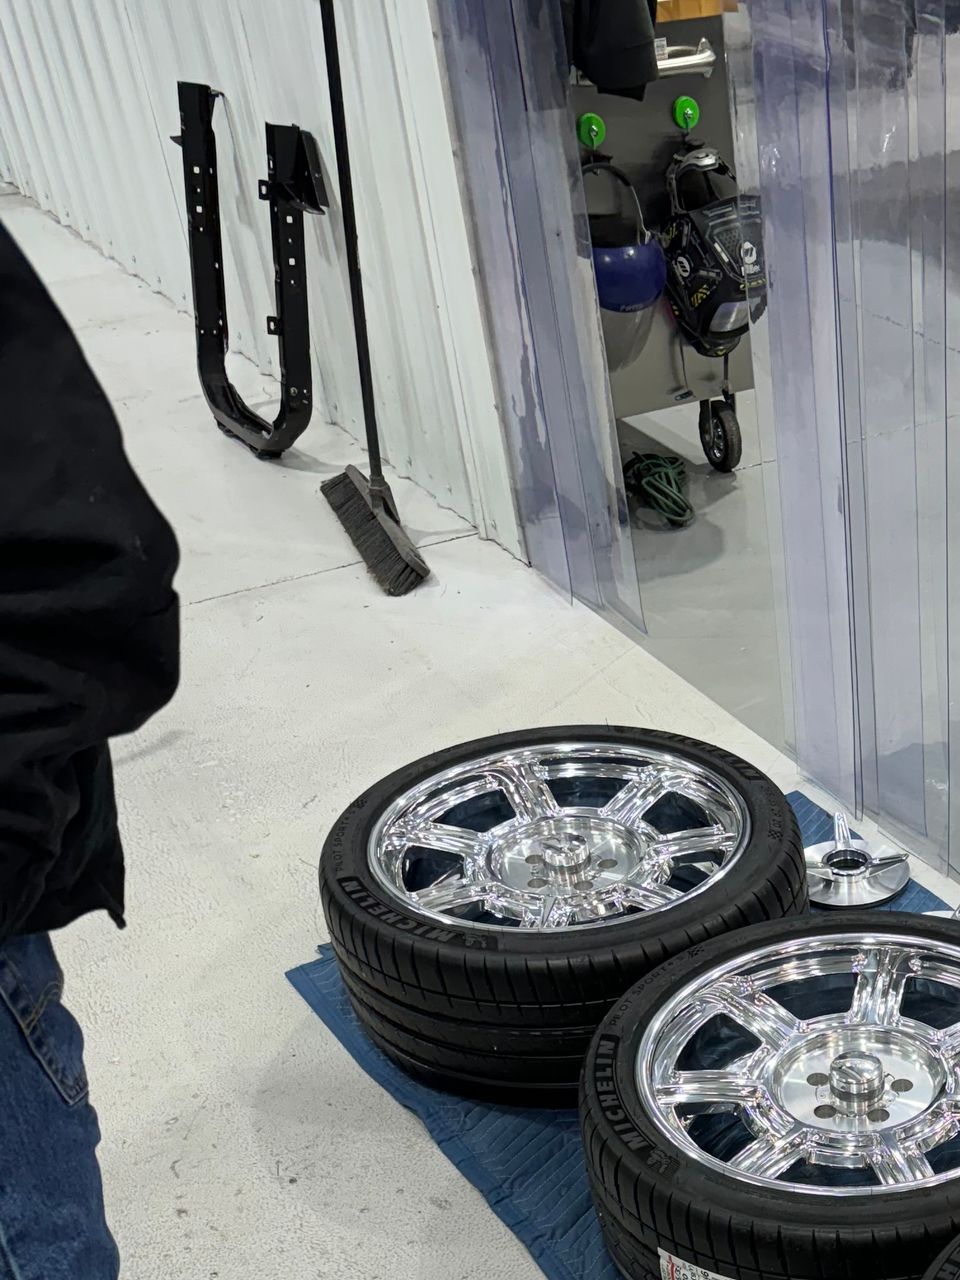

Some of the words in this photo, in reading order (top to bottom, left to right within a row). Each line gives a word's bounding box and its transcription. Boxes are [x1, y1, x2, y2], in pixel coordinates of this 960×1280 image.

[341, 880, 457, 943] MICHELIN
[610, 998, 634, 1027] PILOT
[631, 964, 668, 997] SPORT
[596, 1039, 649, 1151] MICHELIN
